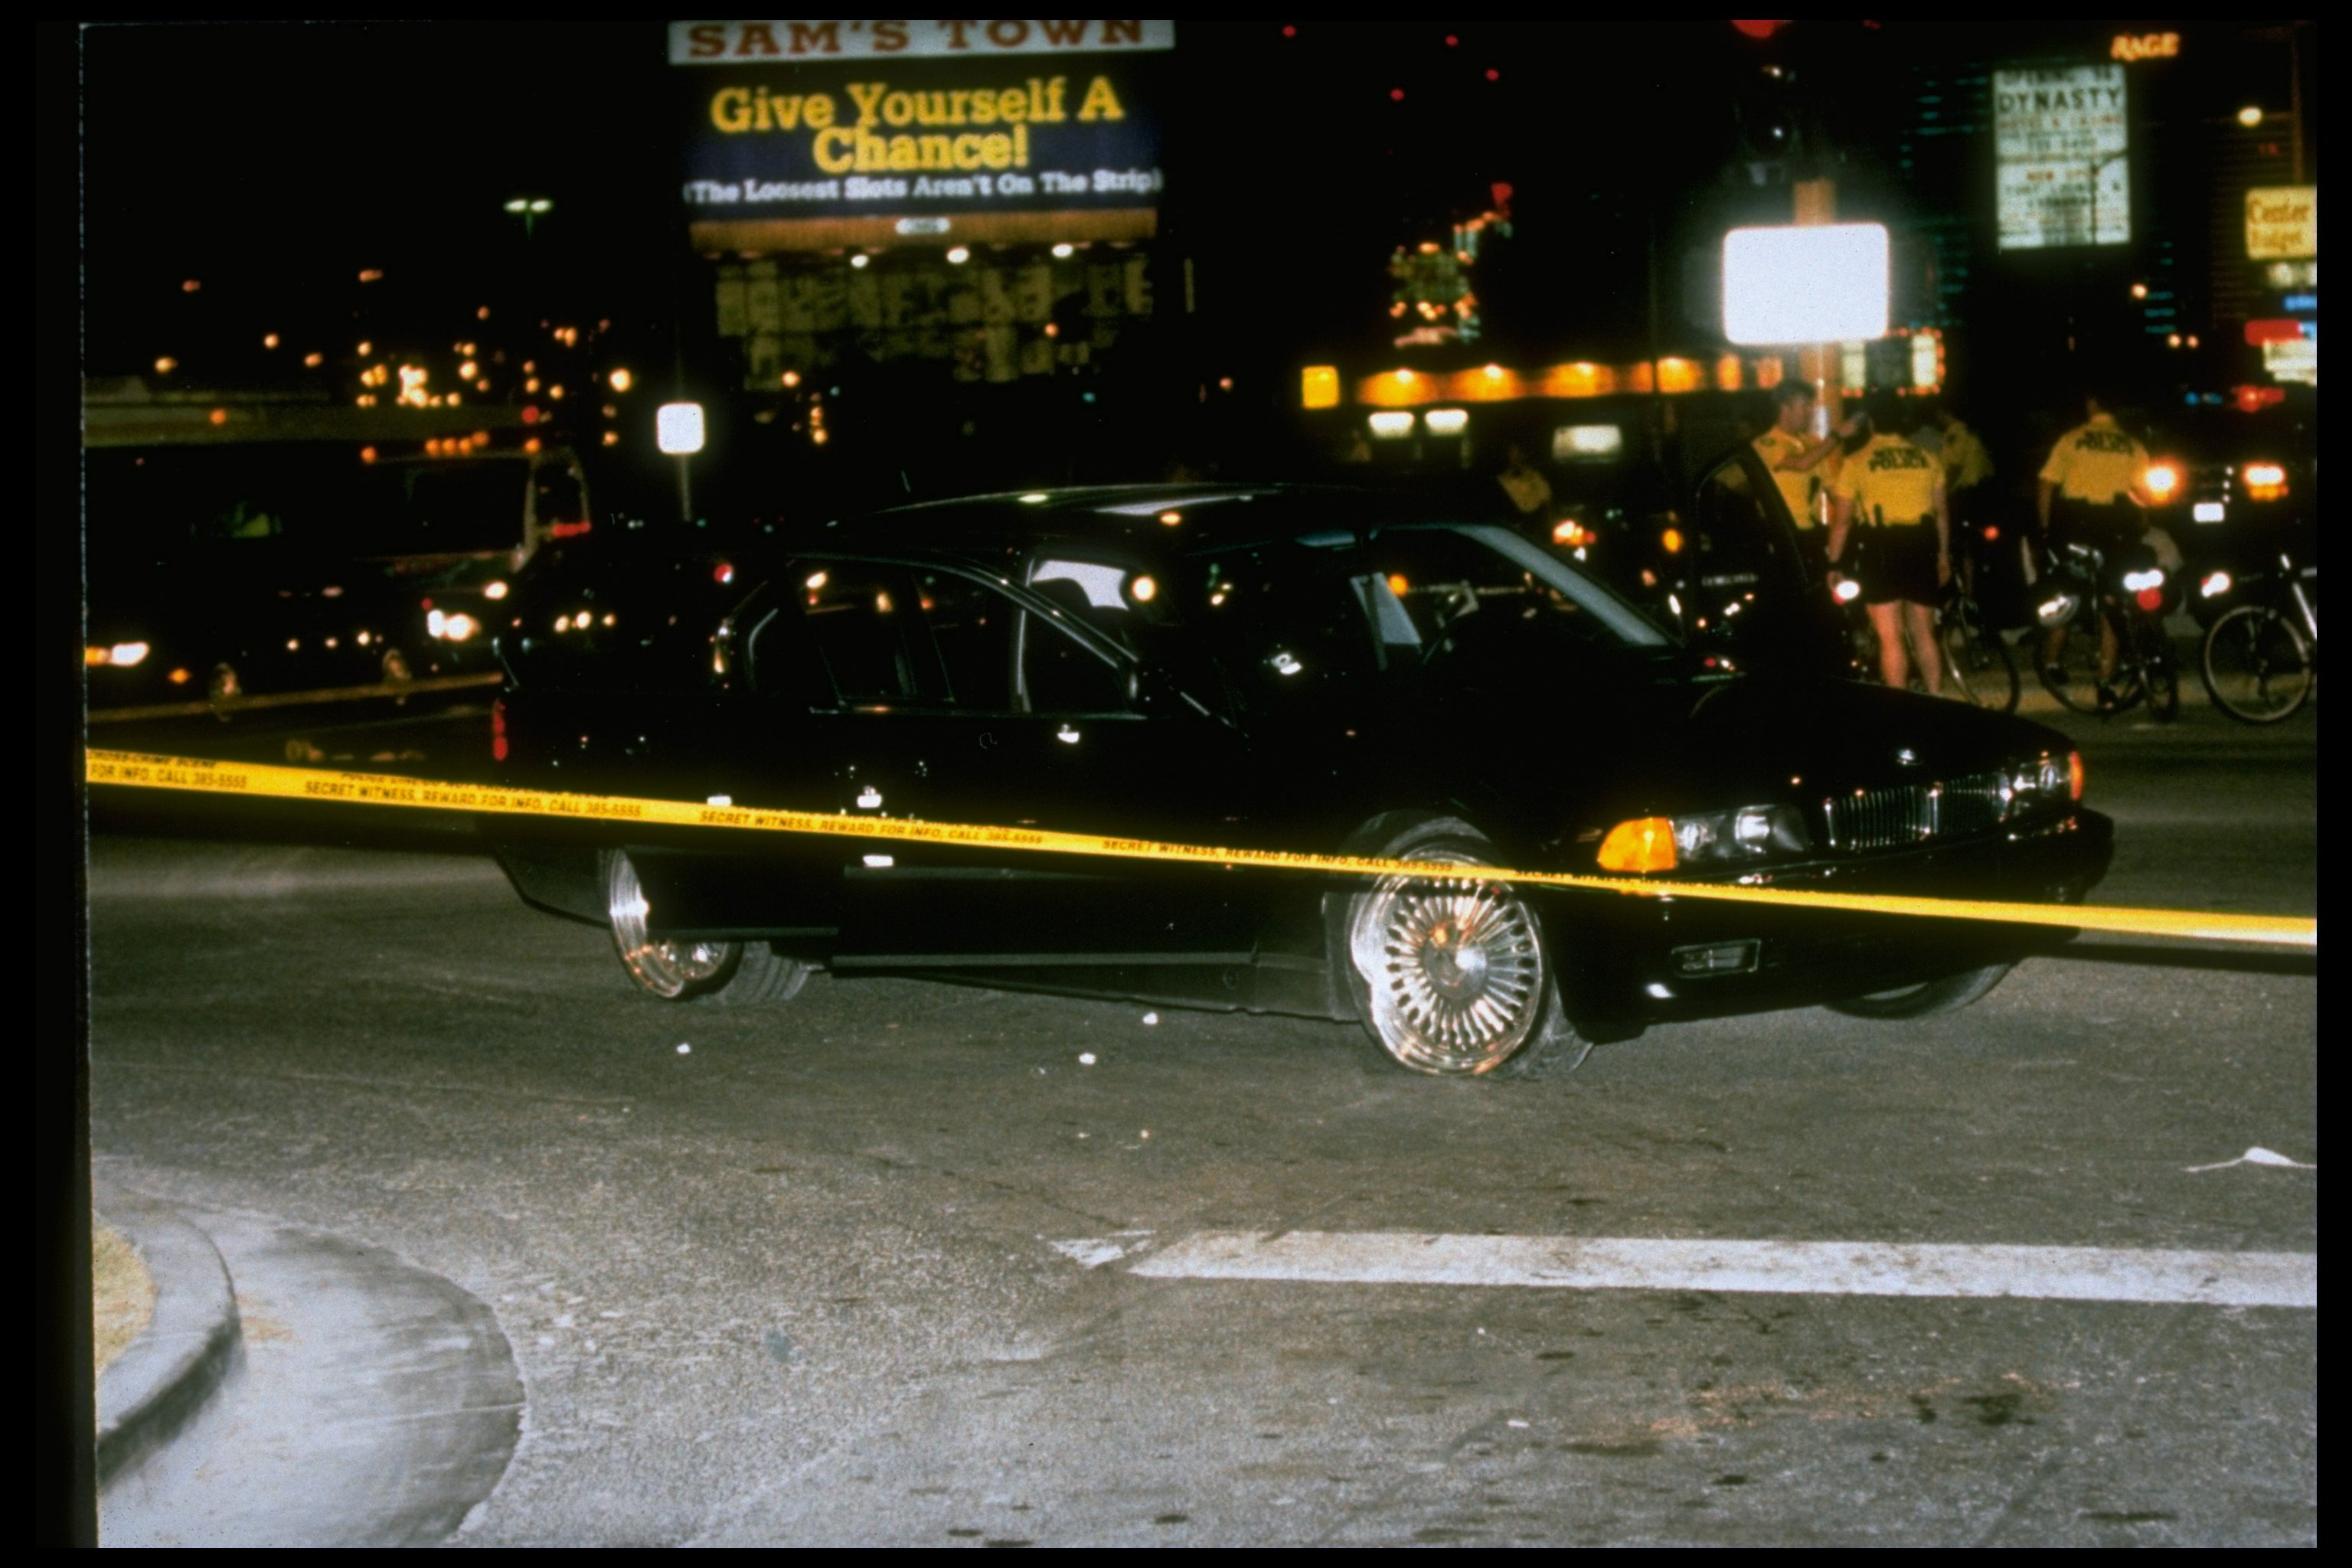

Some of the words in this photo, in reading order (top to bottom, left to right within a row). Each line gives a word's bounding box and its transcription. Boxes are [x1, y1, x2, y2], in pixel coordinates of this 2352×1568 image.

[688, 20, 911, 57] SAM'S
[942, 20, 1145, 49] TOWN
[710, 86, 835, 132] Give
[847, 77, 1067, 127] Yourself
[1078, 76, 1125, 120] A
[1998, 88, 2120, 113] DYNASTY
[812, 123, 1029, 173] Chance!
[743, 177, 840, 203] Loosest
[844, 175, 909, 200] Slots
[913, 174, 993, 198] Aren't
[997, 172, 1034, 195] On
[1038, 170, 1089, 194] The
[1870, 457, 1929, 472] POLICE
[157, 768, 188, 785] CALL
[306, 781, 354, 795] SECRET
[423, 790, 476, 804] REWARD
[482, 794, 506, 806] FOR
[549, 800, 580, 813] CALL
[701, 811, 750, 825] SECRET
[820, 820, 874, 834] REWARD
[880, 823, 905, 835] FOR
[949, 829, 979, 841] CALL
[1102, 841, 1153, 852] SECRET
